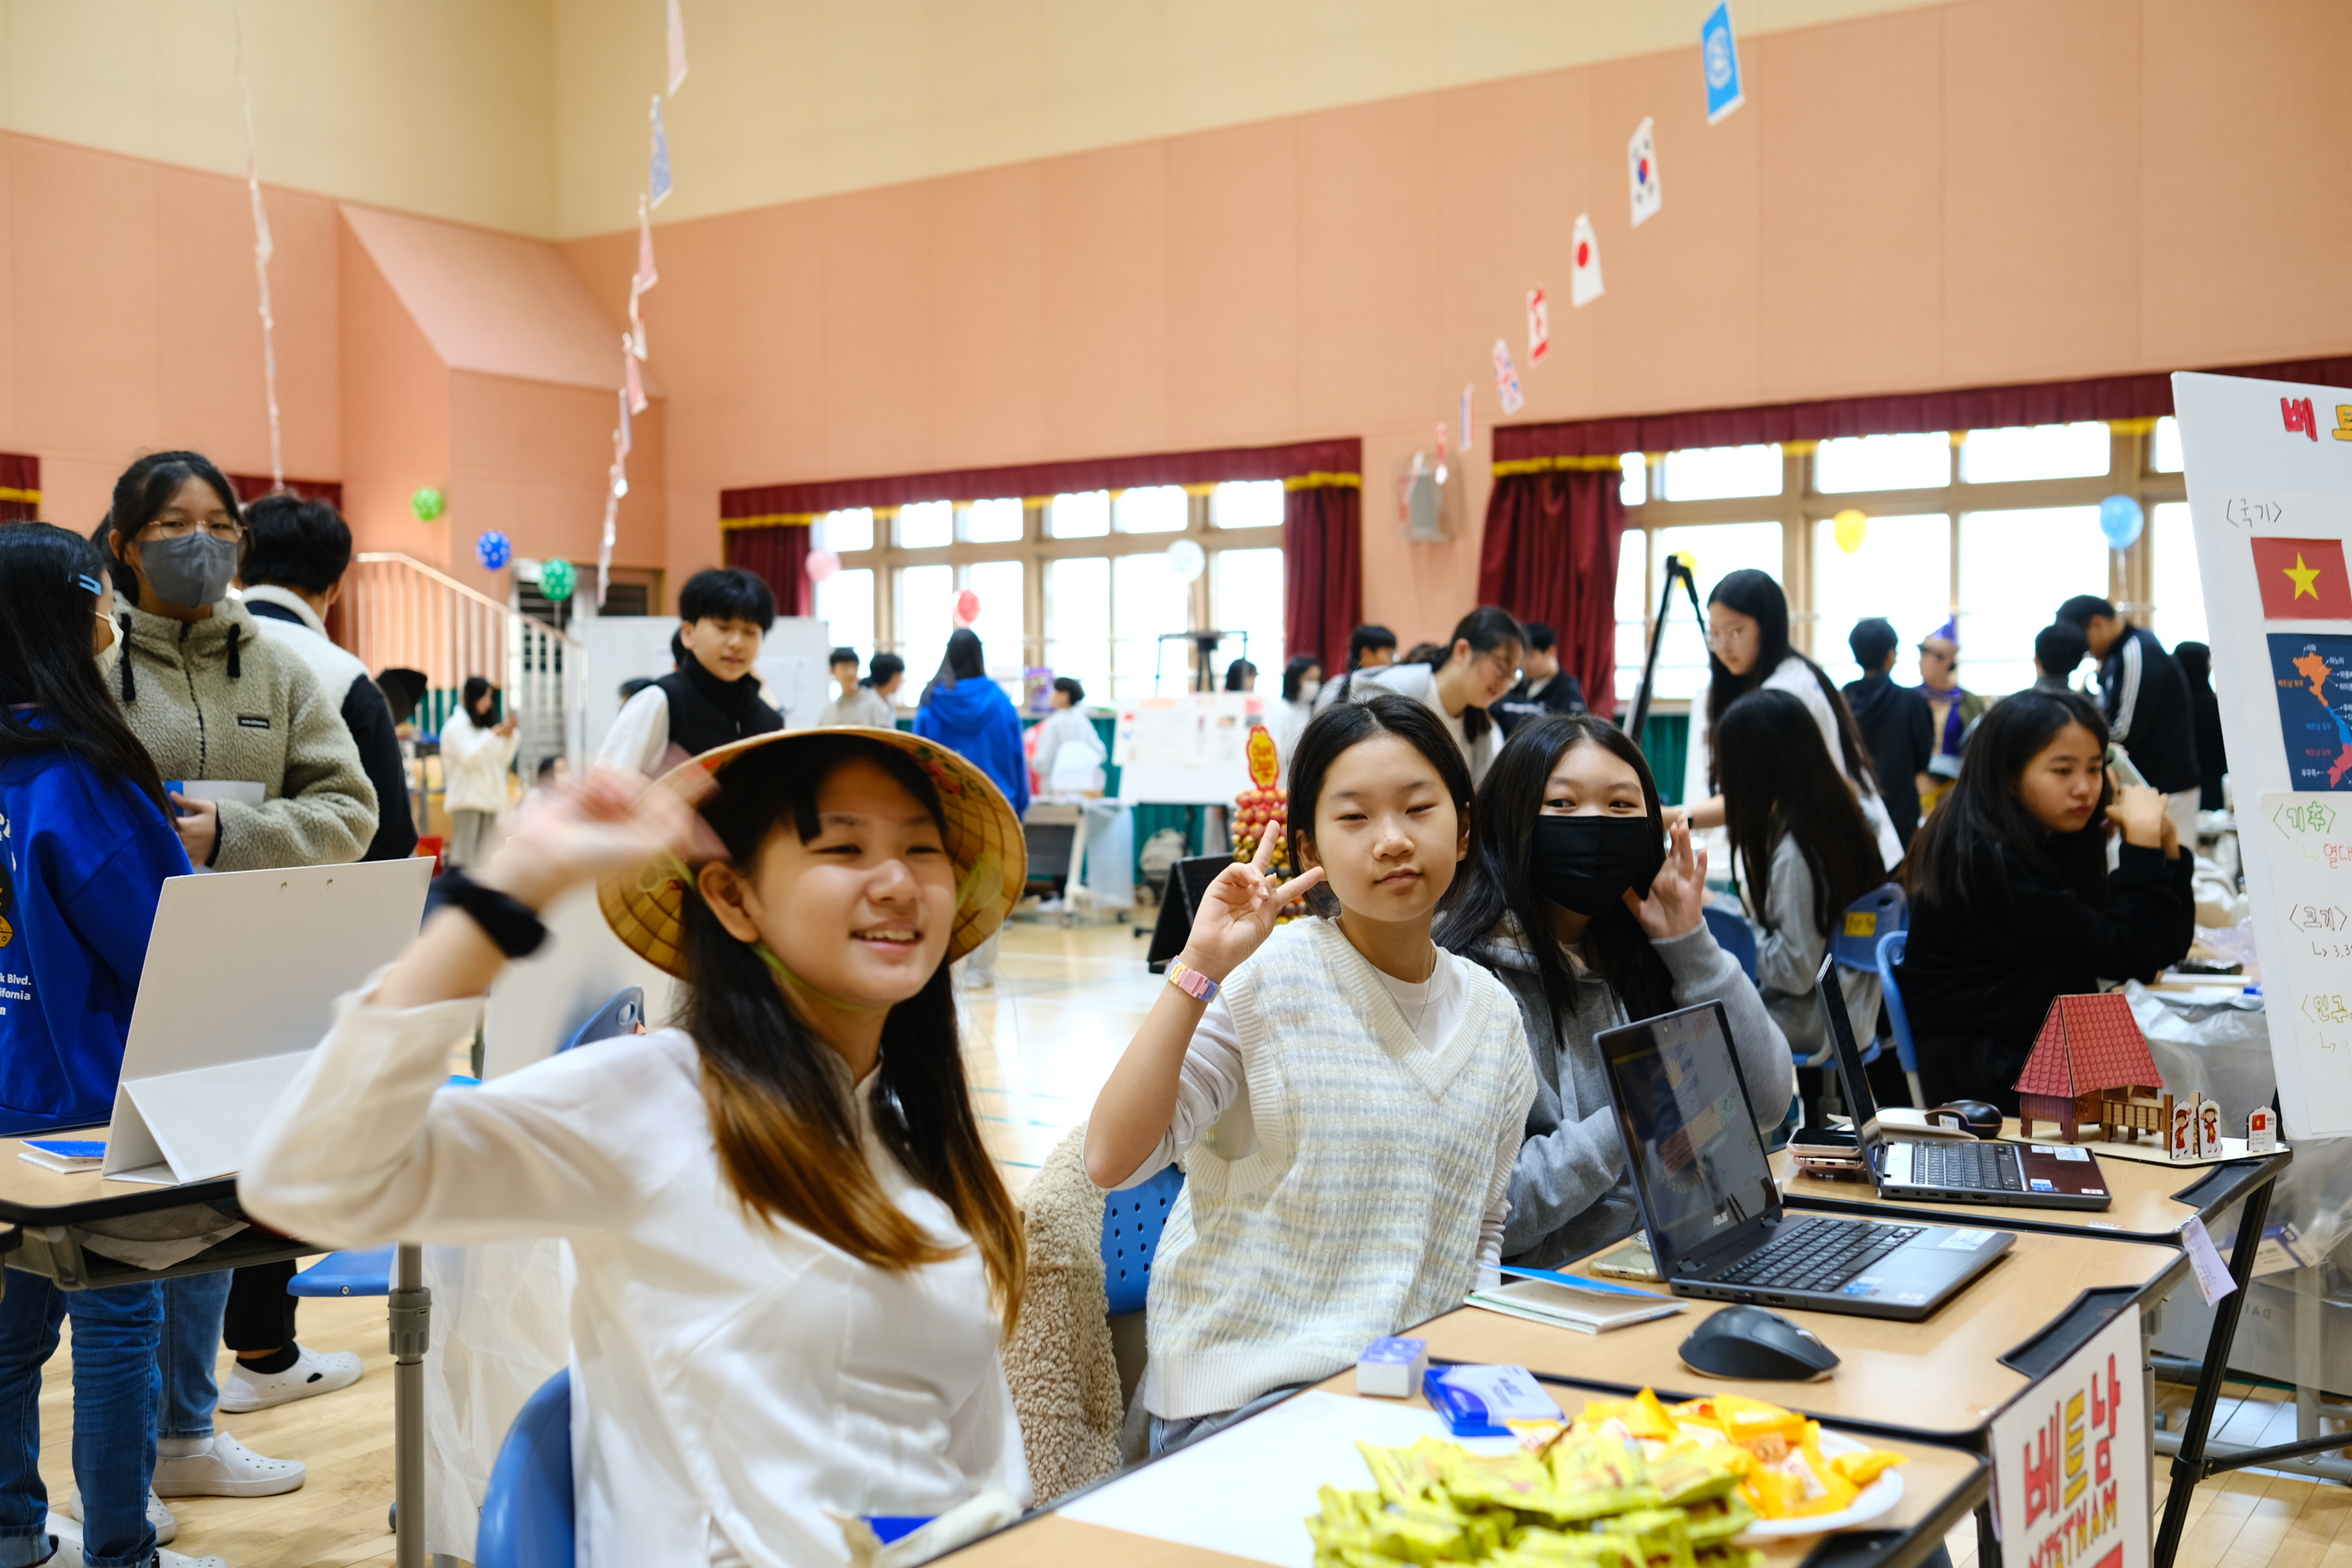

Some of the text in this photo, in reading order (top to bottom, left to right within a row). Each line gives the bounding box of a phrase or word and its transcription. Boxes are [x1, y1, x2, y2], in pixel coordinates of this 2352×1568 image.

[2329, 657, 2344, 665] 하노이
[8, 973, 32, 985] Blvd.
[1713, 1211, 1729, 1227] ASUS
[2023, 1352, 2121, 1530] 베트남
